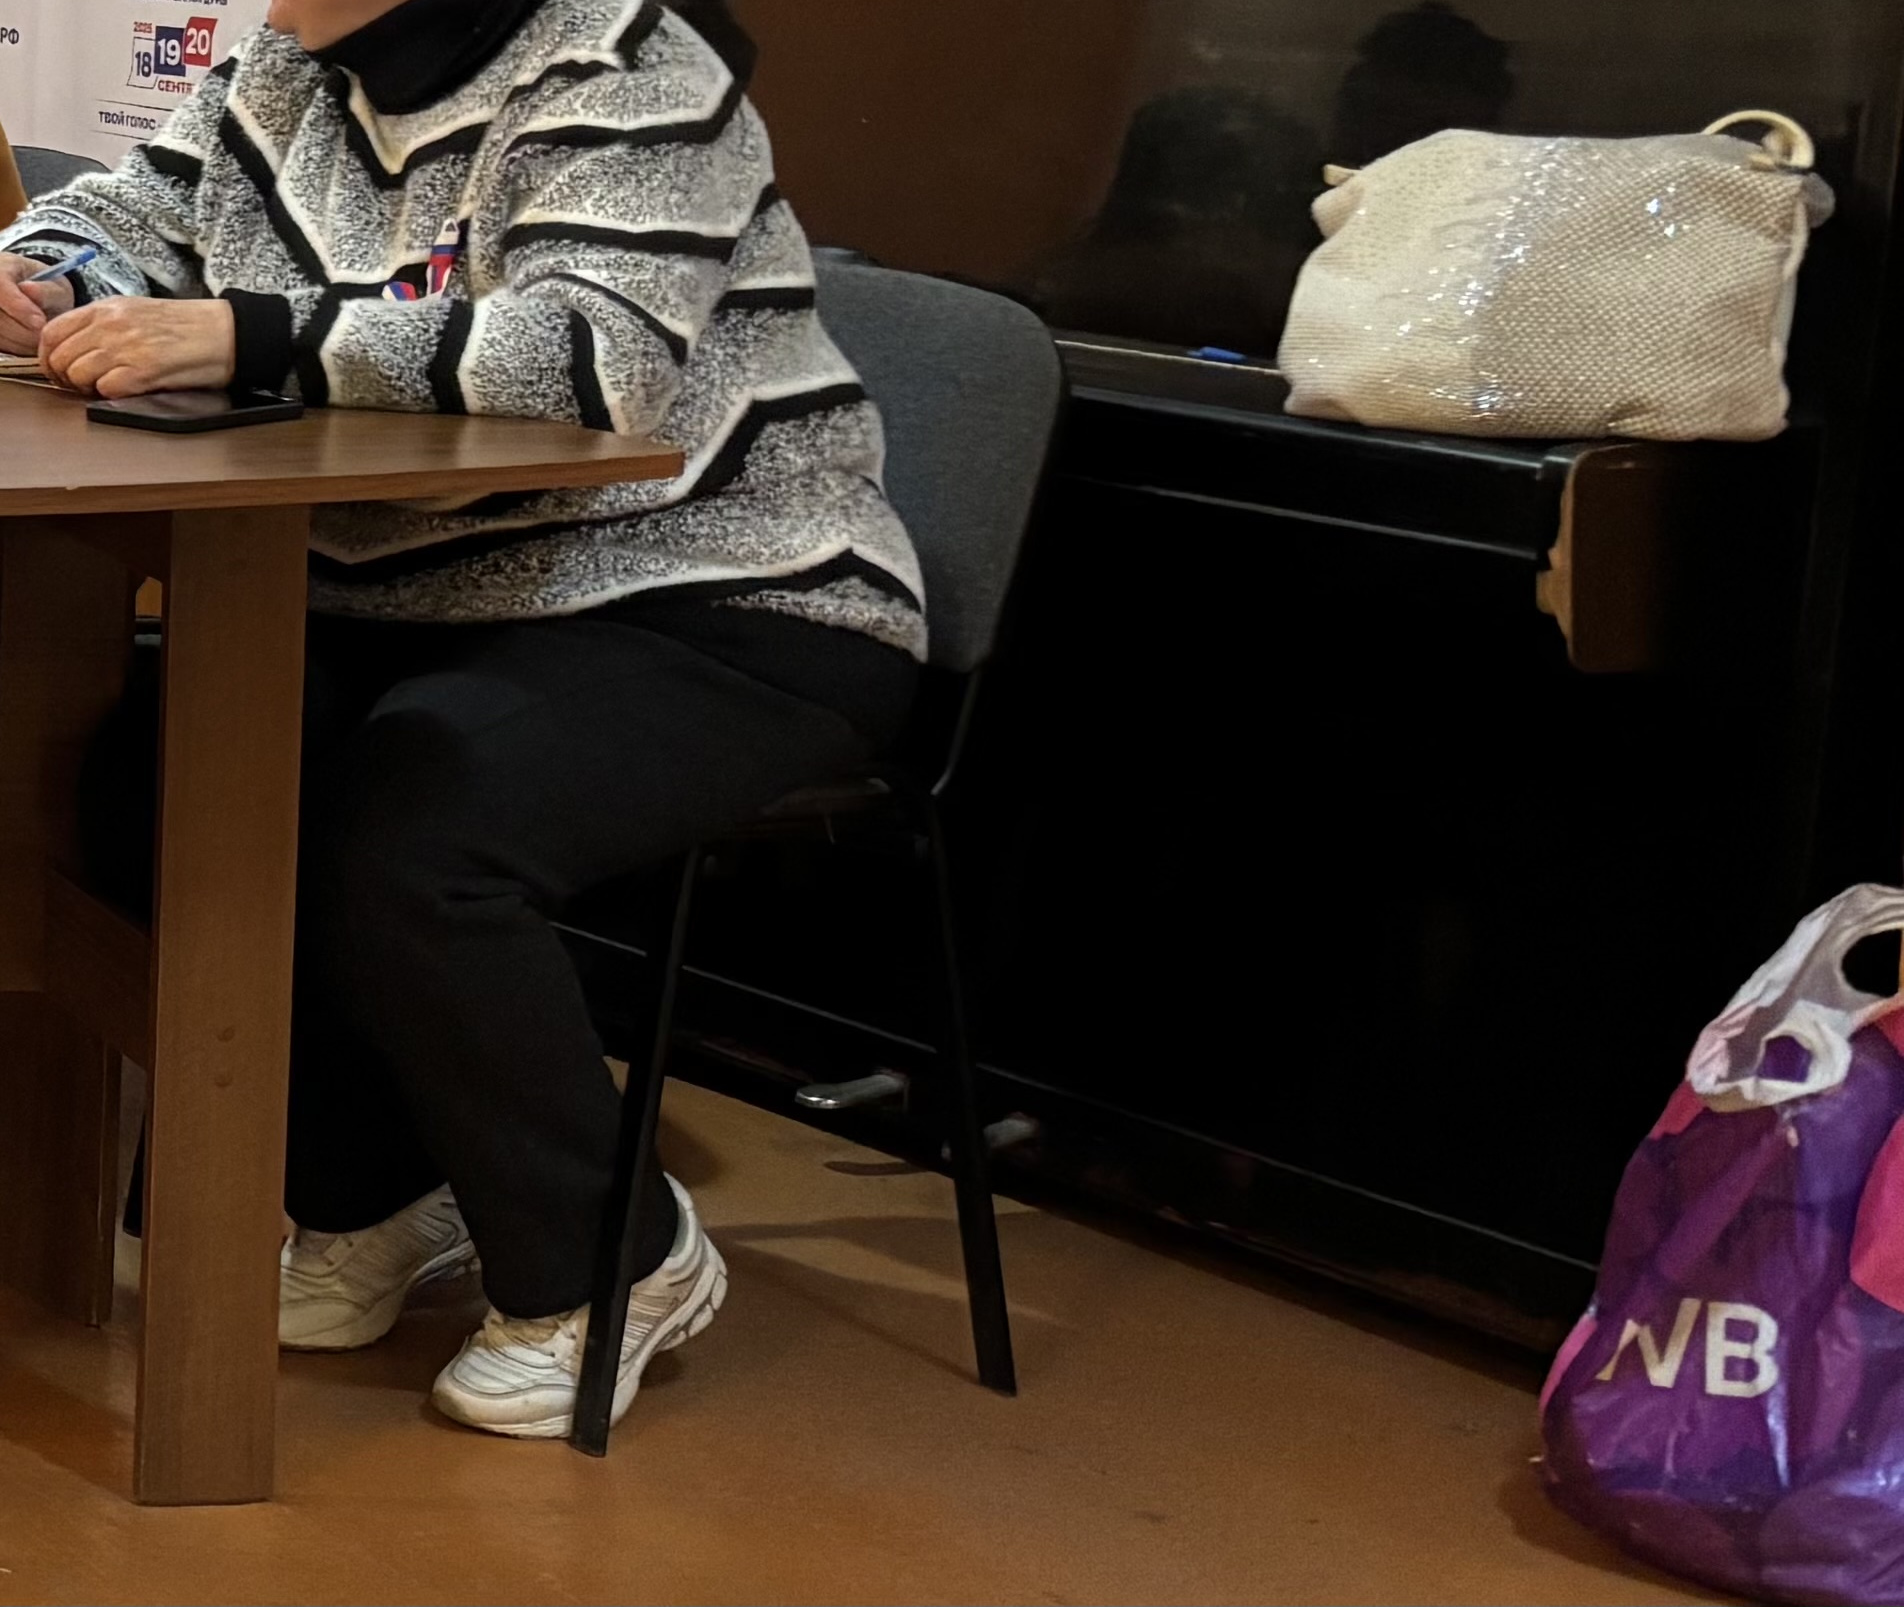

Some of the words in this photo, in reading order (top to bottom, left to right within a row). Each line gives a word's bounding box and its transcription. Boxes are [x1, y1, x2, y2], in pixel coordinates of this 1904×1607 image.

[134, 51, 152, 77] 18
[157, 39, 181, 66] 19
[185, 28, 210, 56] 20
